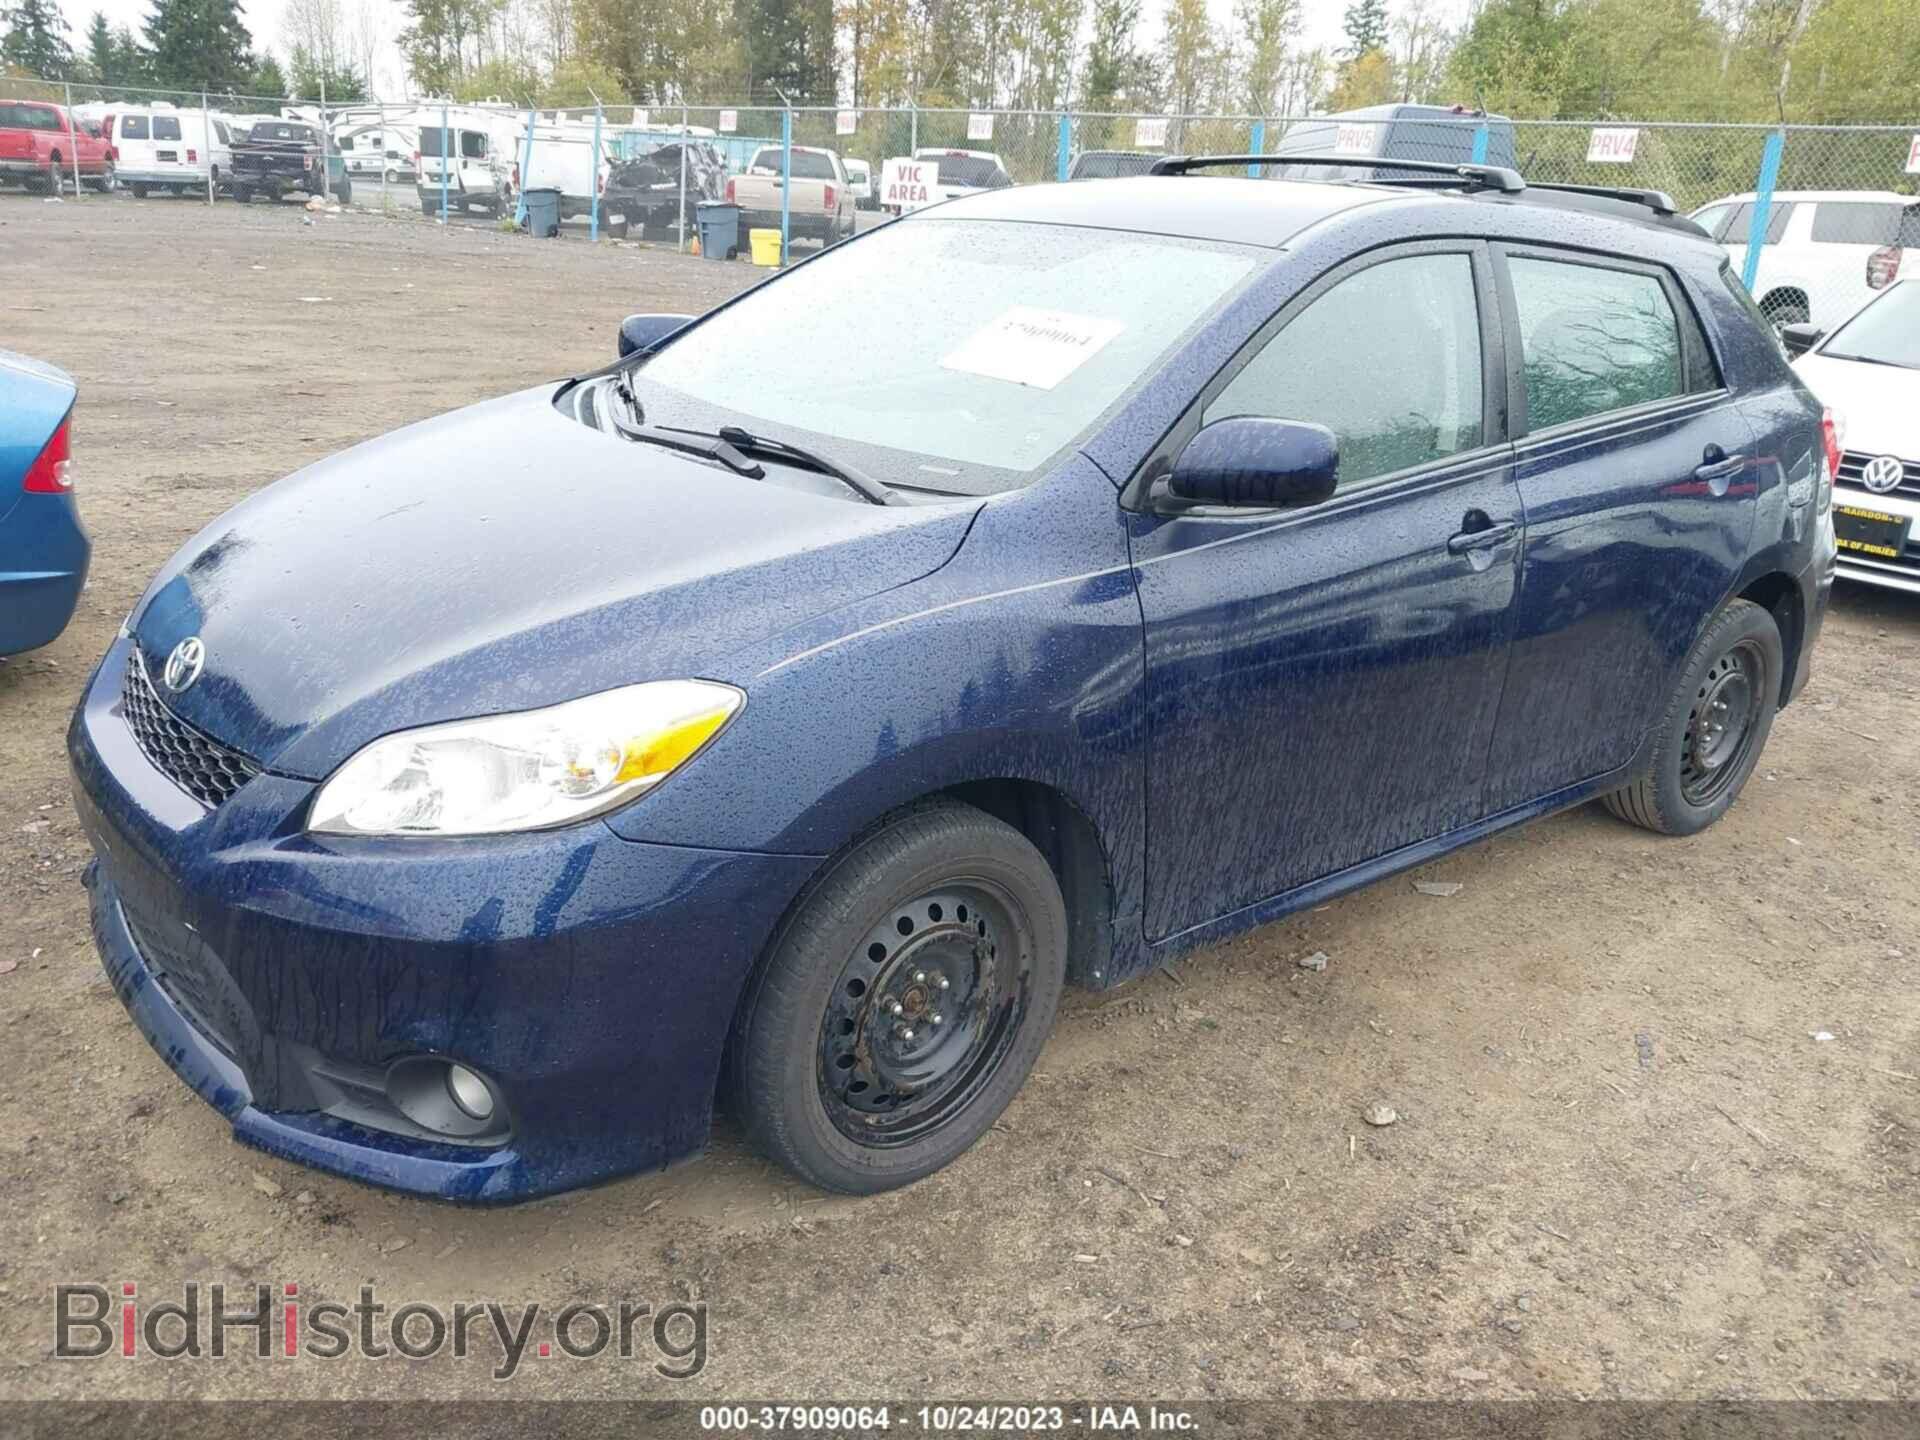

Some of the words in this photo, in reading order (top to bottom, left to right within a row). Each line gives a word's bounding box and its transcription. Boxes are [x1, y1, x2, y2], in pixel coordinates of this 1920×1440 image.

[1590, 134, 1633, 156] PRV4
[898, 165, 922, 183] VIC
[888, 184, 928, 201] AREA
